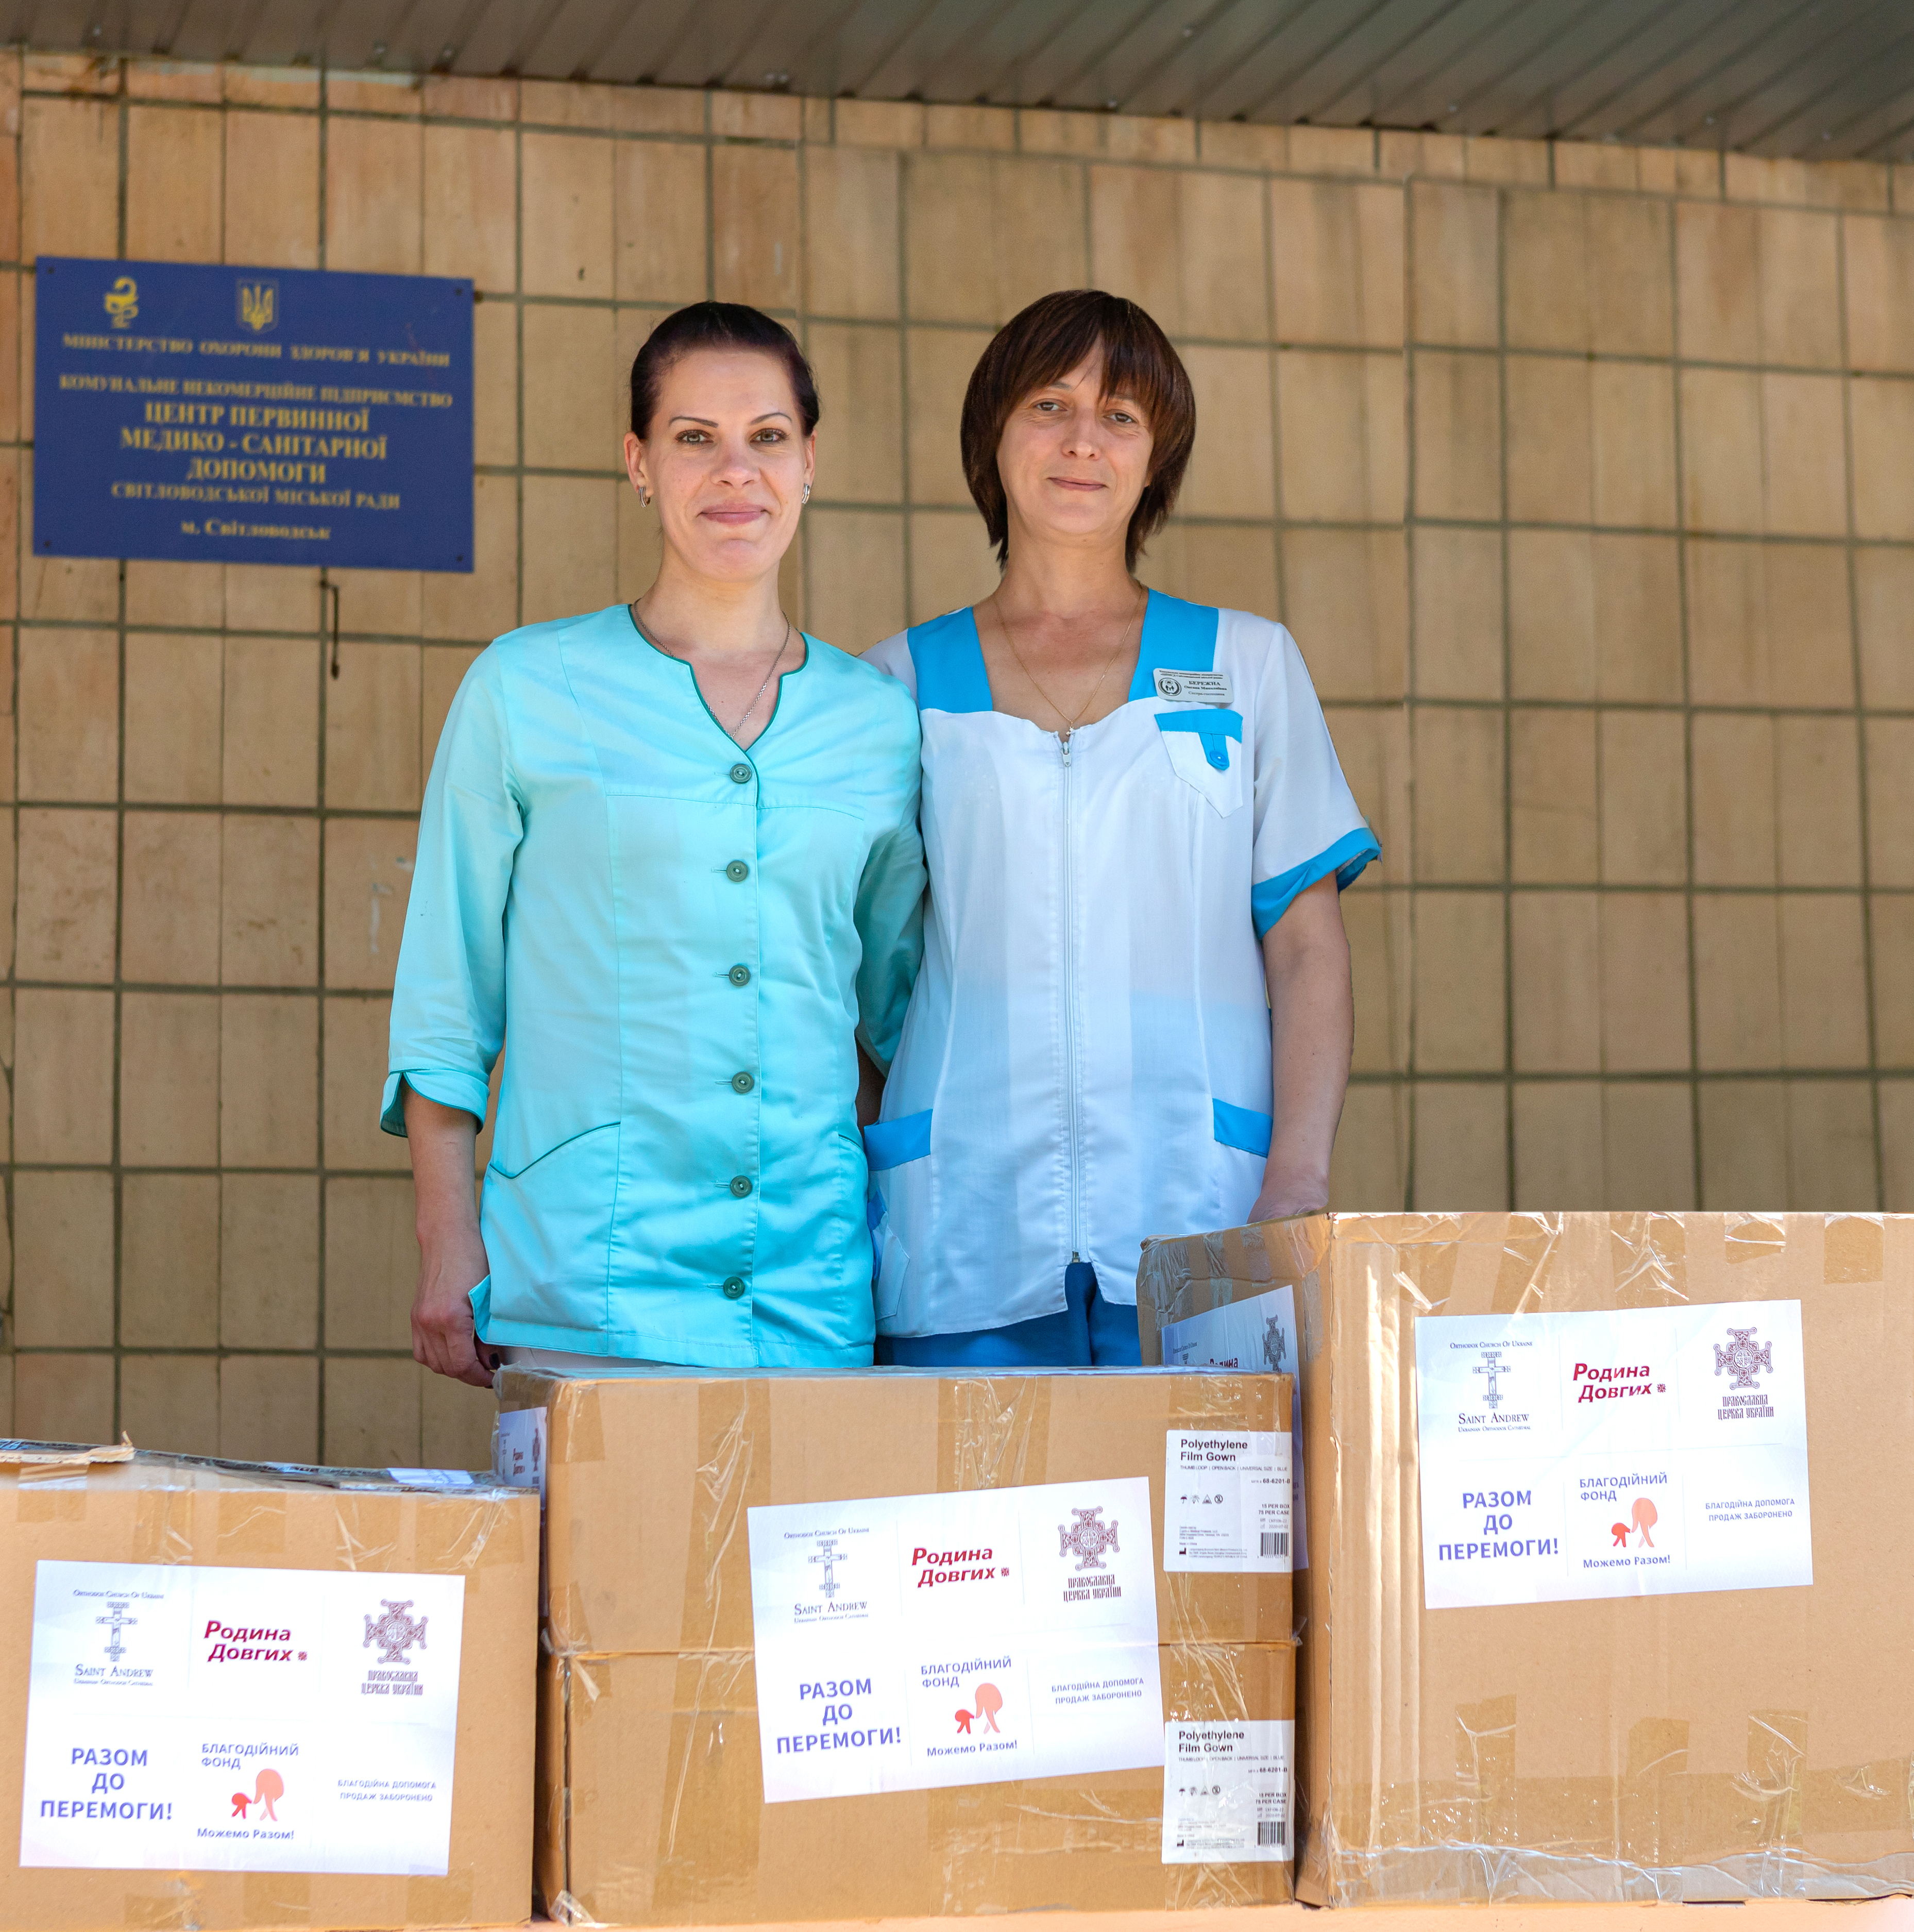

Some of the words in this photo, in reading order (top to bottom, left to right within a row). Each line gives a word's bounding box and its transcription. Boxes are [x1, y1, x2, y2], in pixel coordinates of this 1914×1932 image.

[199, 341, 282, 359] ОХОРОНИ
[377, 348, 450, 367] УКРАЇНИ
[145, 401, 225, 426] ЦЕНТР
[230, 405, 369, 432] ПЕРВИННОЇ
[120, 426, 225, 453] МЕДИКО
[242, 432, 387, 460] САНІТАРНОЇ
[186, 457, 326, 484] ДОПОМОГИ
[355, 492, 400, 510] РАДИ
[1573, 1365, 1650, 1382] Родина
[1578, 1383, 1652, 1403] Довгих
[1181, 1439, 1248, 1451] Polyethylene
[1180, 1451, 1202, 1461] Film
[1206, 1452, 1235, 1461] Gown
[1580, 1472, 1667, 1488] БЛАГОДІЙНИЙ
[1463, 1490, 1532, 1509] РАЗОМ
[1581, 1490, 1617, 1502] ФОНД
[1705, 1500, 1753, 1509] БЛАГОДІЙНА
[1755, 1499, 1795, 1508] ДОПОМОГА
[1483, 1514, 1513, 1535] ДО
[1708, 1513, 1742, 1522] ПРОДАЖ
[1744, 1510, 1792, 1520] ЗАБОРОНЕНО
[912, 1548, 993, 1566] Родина
[1439, 1538, 1559, 1560] ПЕРЕМОГИ!
[1583, 1557, 1631, 1568] Можемо
[1634, 1555, 1670, 1566] Разом!
[918, 1567, 996, 1588] Довгих
[204, 1620, 292, 1642] Родина
[207, 1643, 294, 1662] Довгих
[921, 1655, 1011, 1675] БЛАГОДІЙНИЙ
[800, 1678, 872, 1700] РАЗОМ
[922, 1676, 959, 1688] ФОНД
[1052, 1681, 1100, 1693] БЛАГОДІЙНА
[1103, 1677, 1144, 1689] ДОПОМОГА
[1056, 1694, 1090, 1705] ПРОДАЖ
[1092, 1690, 1142, 1701] ЗАБОРОНЕНО
[822, 1703, 853, 1726] ДО
[776, 1726, 901, 1754] ПЕРЕМОГИ!
[1179, 1730, 1244, 1742] Polyethylene
[202, 1742, 300, 1757] БЛАГОДІЙНИЙ
[927, 1745, 976, 1757] Можемо
[979, 1739, 1018, 1752] Разом!
[1179, 1743, 1200, 1753] Film
[1204, 1742, 1233, 1753] Gown
[71, 1748, 148, 1767] РАЗОМ
[201, 1757, 242, 1770] ФОНД
[91, 1772, 125, 1794] ДО
[337, 1779, 390, 1788] БЛАГОДІЙНА
[392, 1780, 437, 1790] ДОПОМОГА
[340, 1792, 377, 1801] ПРОДАЖ
[379, 1793, 433, 1802] ЗАБОРОНЕНО
[40, 1800, 173, 1820] ПЕРЕМОГИ!
[197, 1827, 249, 1838] Можемо
[253, 1829, 295, 1840] Разом!
